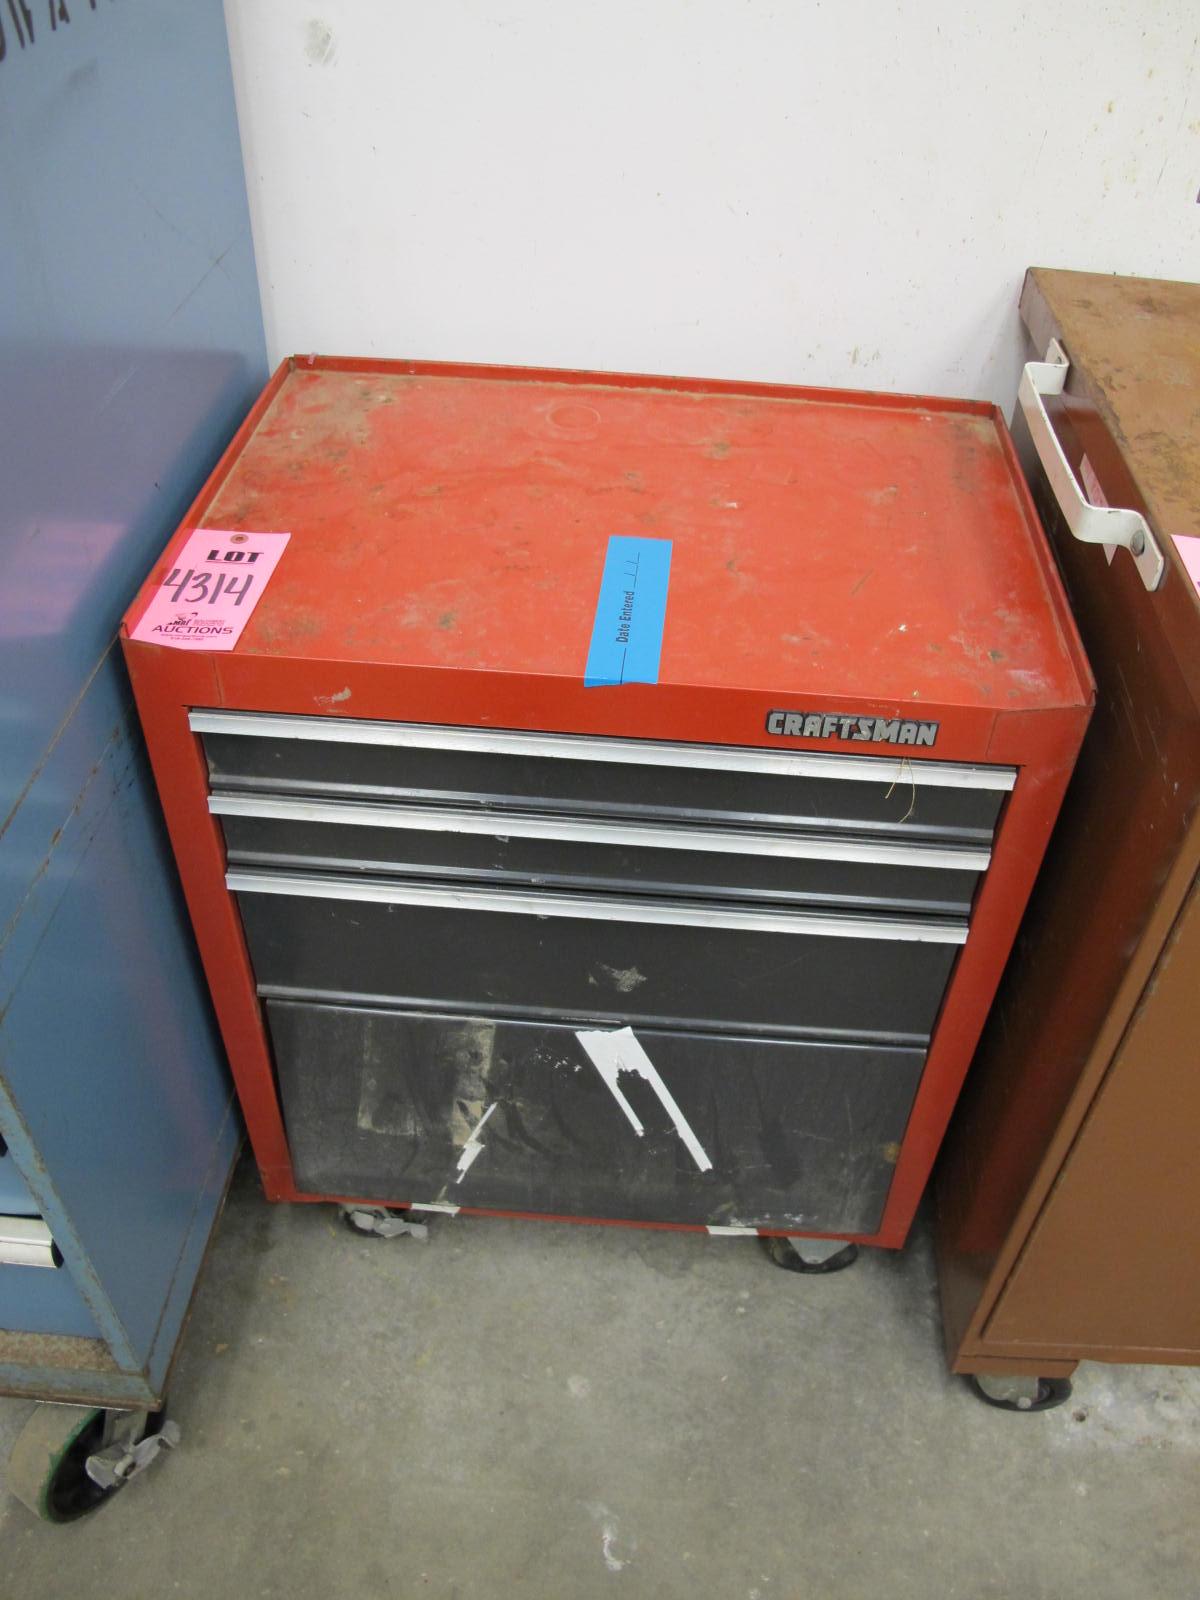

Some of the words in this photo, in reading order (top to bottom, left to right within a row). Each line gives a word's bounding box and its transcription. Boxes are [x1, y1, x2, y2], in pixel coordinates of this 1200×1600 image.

[206, 550, 264, 563] LOT
[163, 568, 254, 606] 4314
[619, 591, 635, 621] Entered
[152, 625, 234, 634] AUCTIONS
[616, 623, 630, 643] Date
[766, 709, 940, 747] CRAFTSMAN
